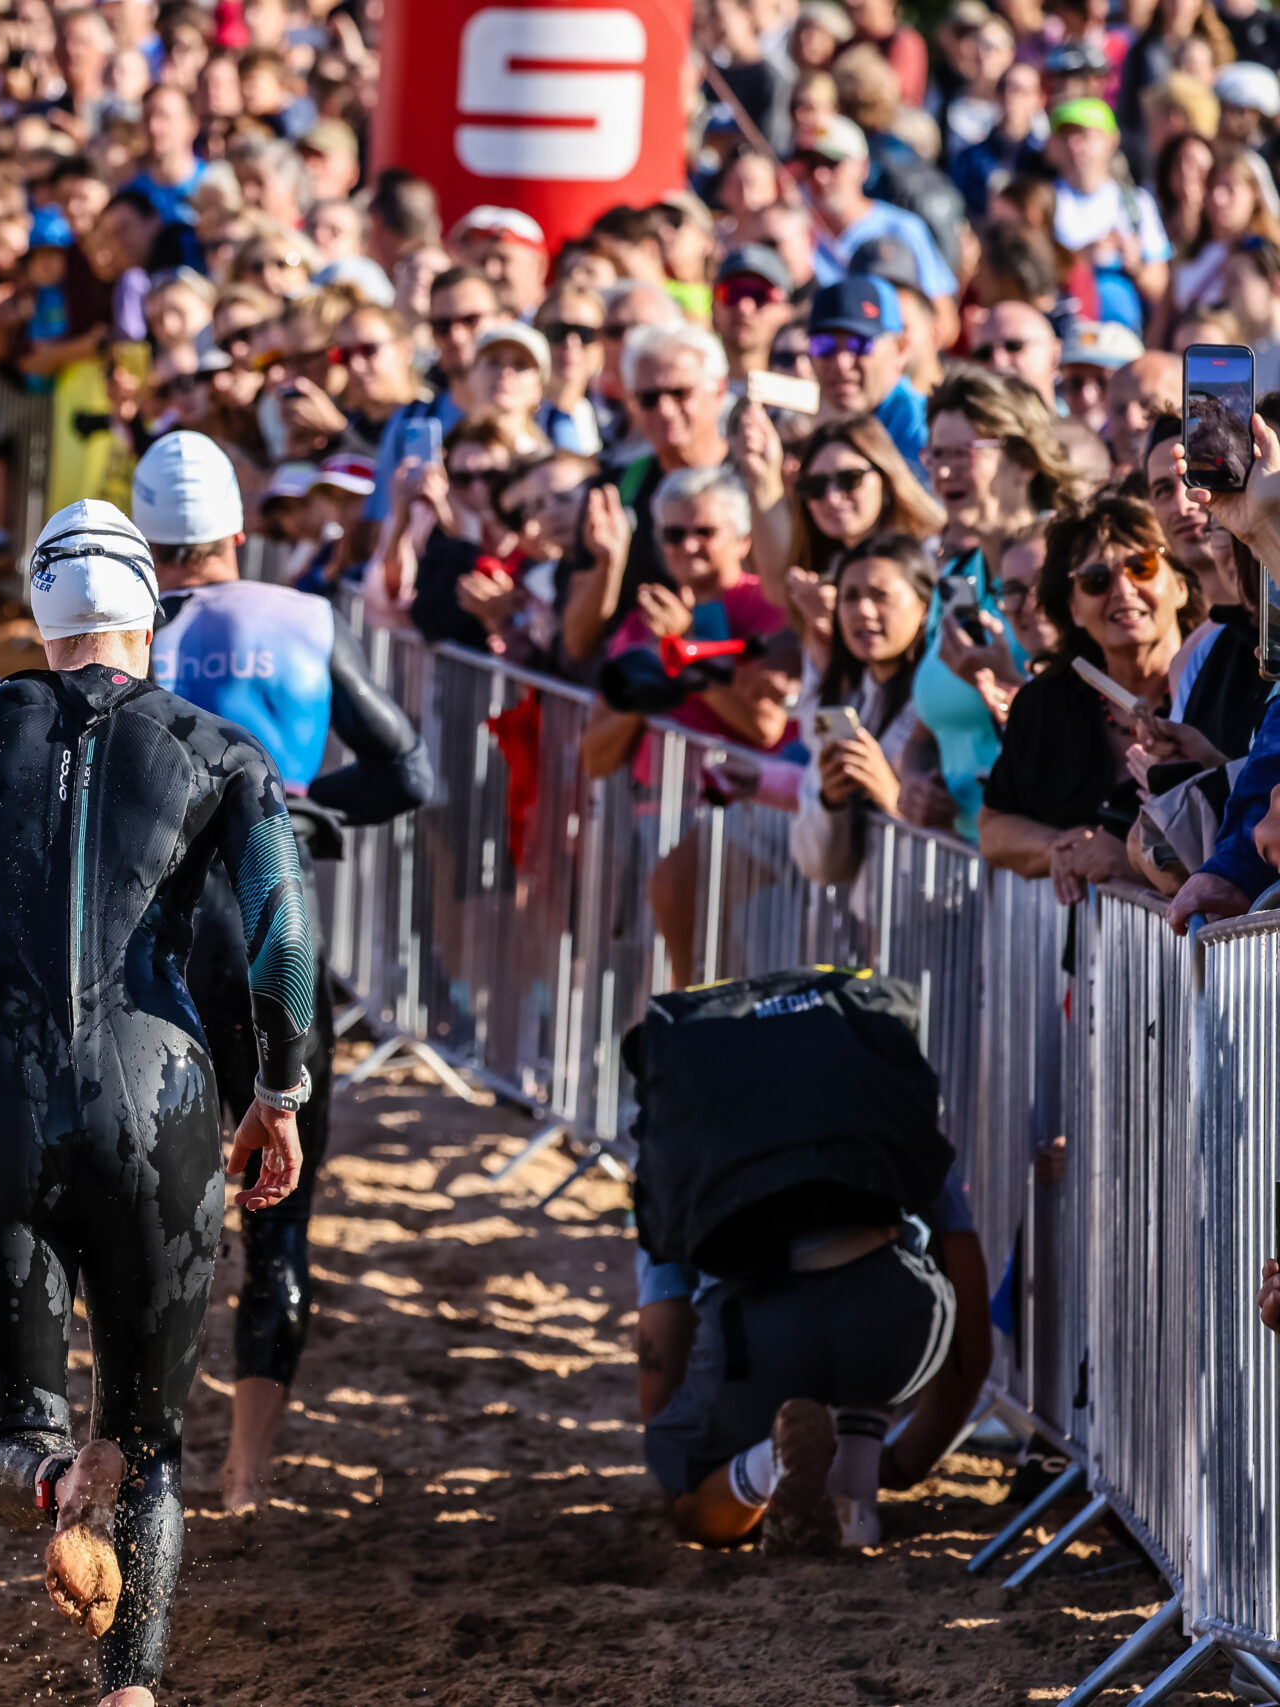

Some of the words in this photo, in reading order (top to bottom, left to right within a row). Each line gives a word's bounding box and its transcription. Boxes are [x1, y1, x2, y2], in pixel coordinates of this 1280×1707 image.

[454, 7, 647, 182] S
[59, 749, 72, 802] orca
[83, 766, 92, 787] FLEX
[753, 988, 823, 1019] MEDIA
